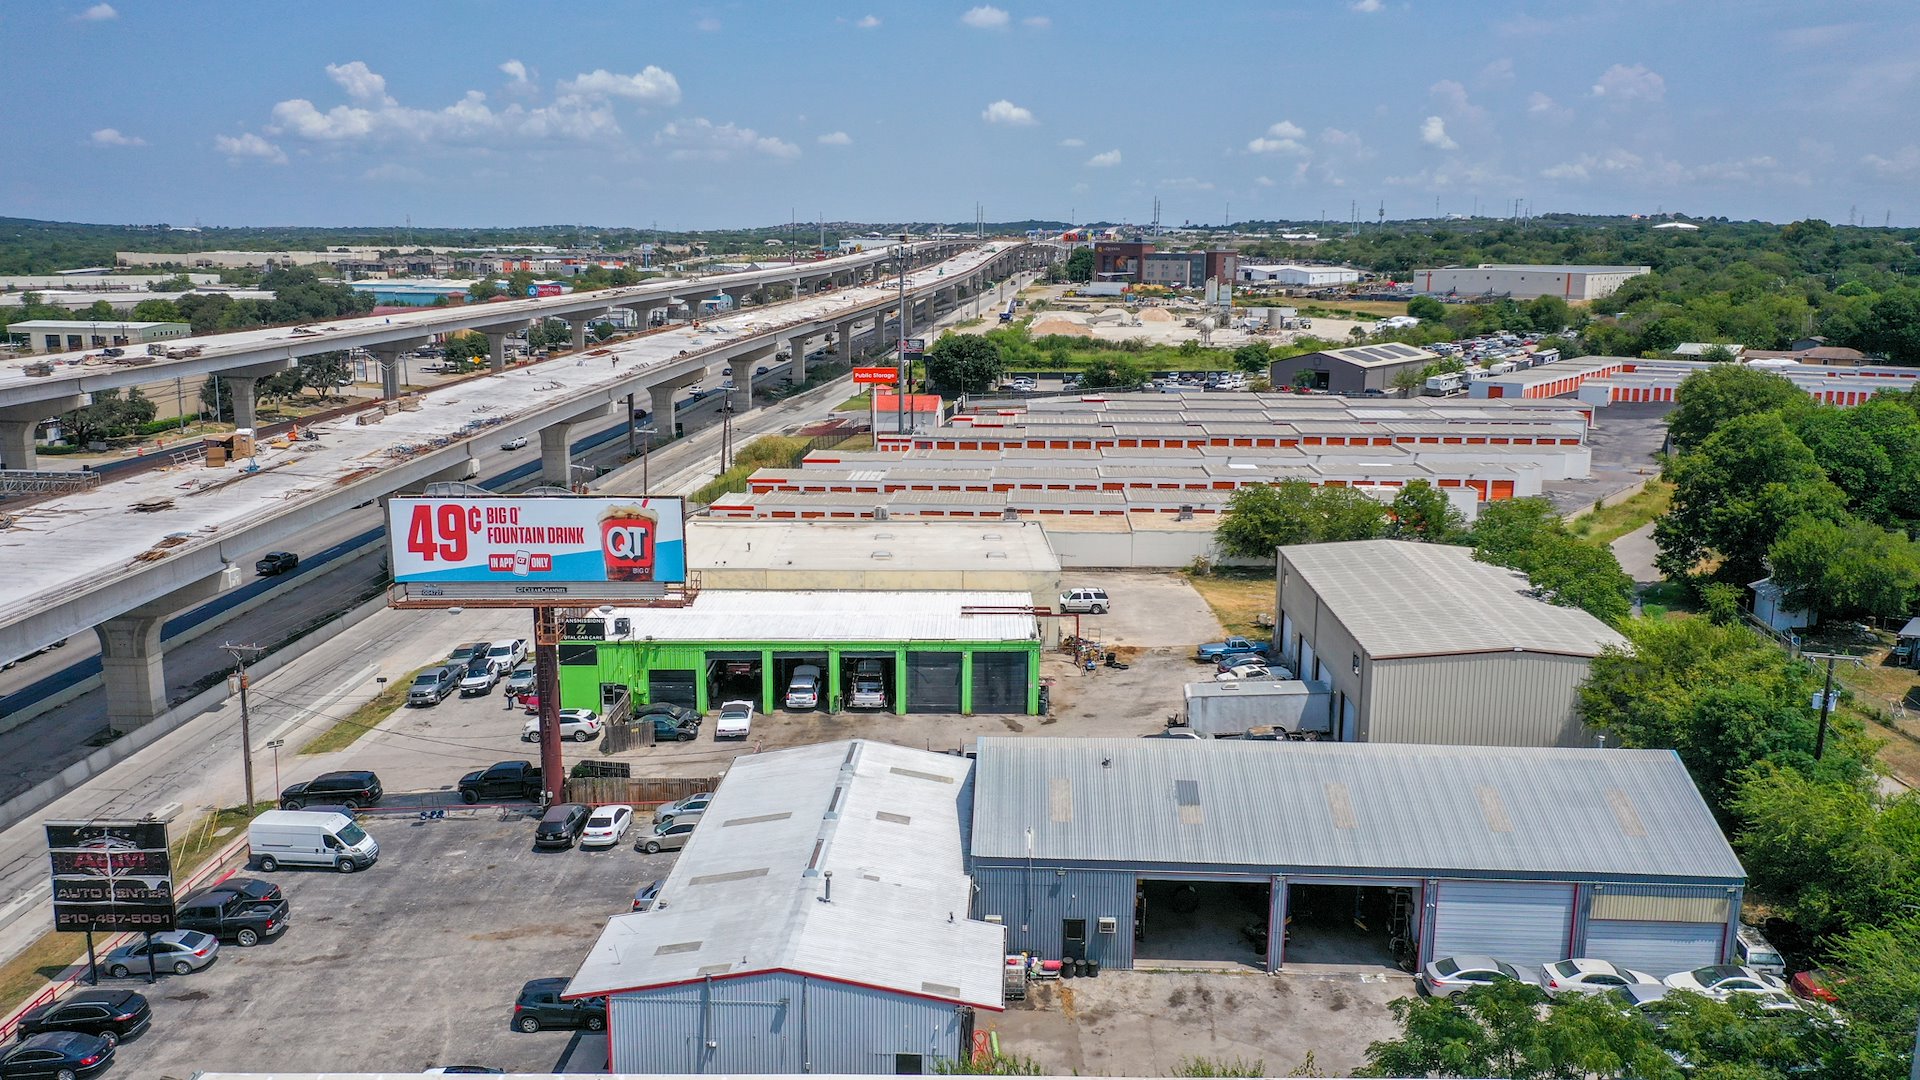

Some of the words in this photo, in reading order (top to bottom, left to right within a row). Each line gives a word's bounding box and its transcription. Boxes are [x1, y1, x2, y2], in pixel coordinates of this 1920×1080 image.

[486, 507, 507, 524] BIG
[487, 526, 545, 544] FOUNTAIN
[547, 526, 585, 544] DRINK
[606, 526, 646, 559] QT
[490, 557, 499, 568] IN
[499, 557, 514, 568] APP
[531, 557, 549, 568] ONLY
[576, 624, 586, 634] Z
[57, 888, 102, 898] AUTO
[105, 888, 169, 898] CENTER
